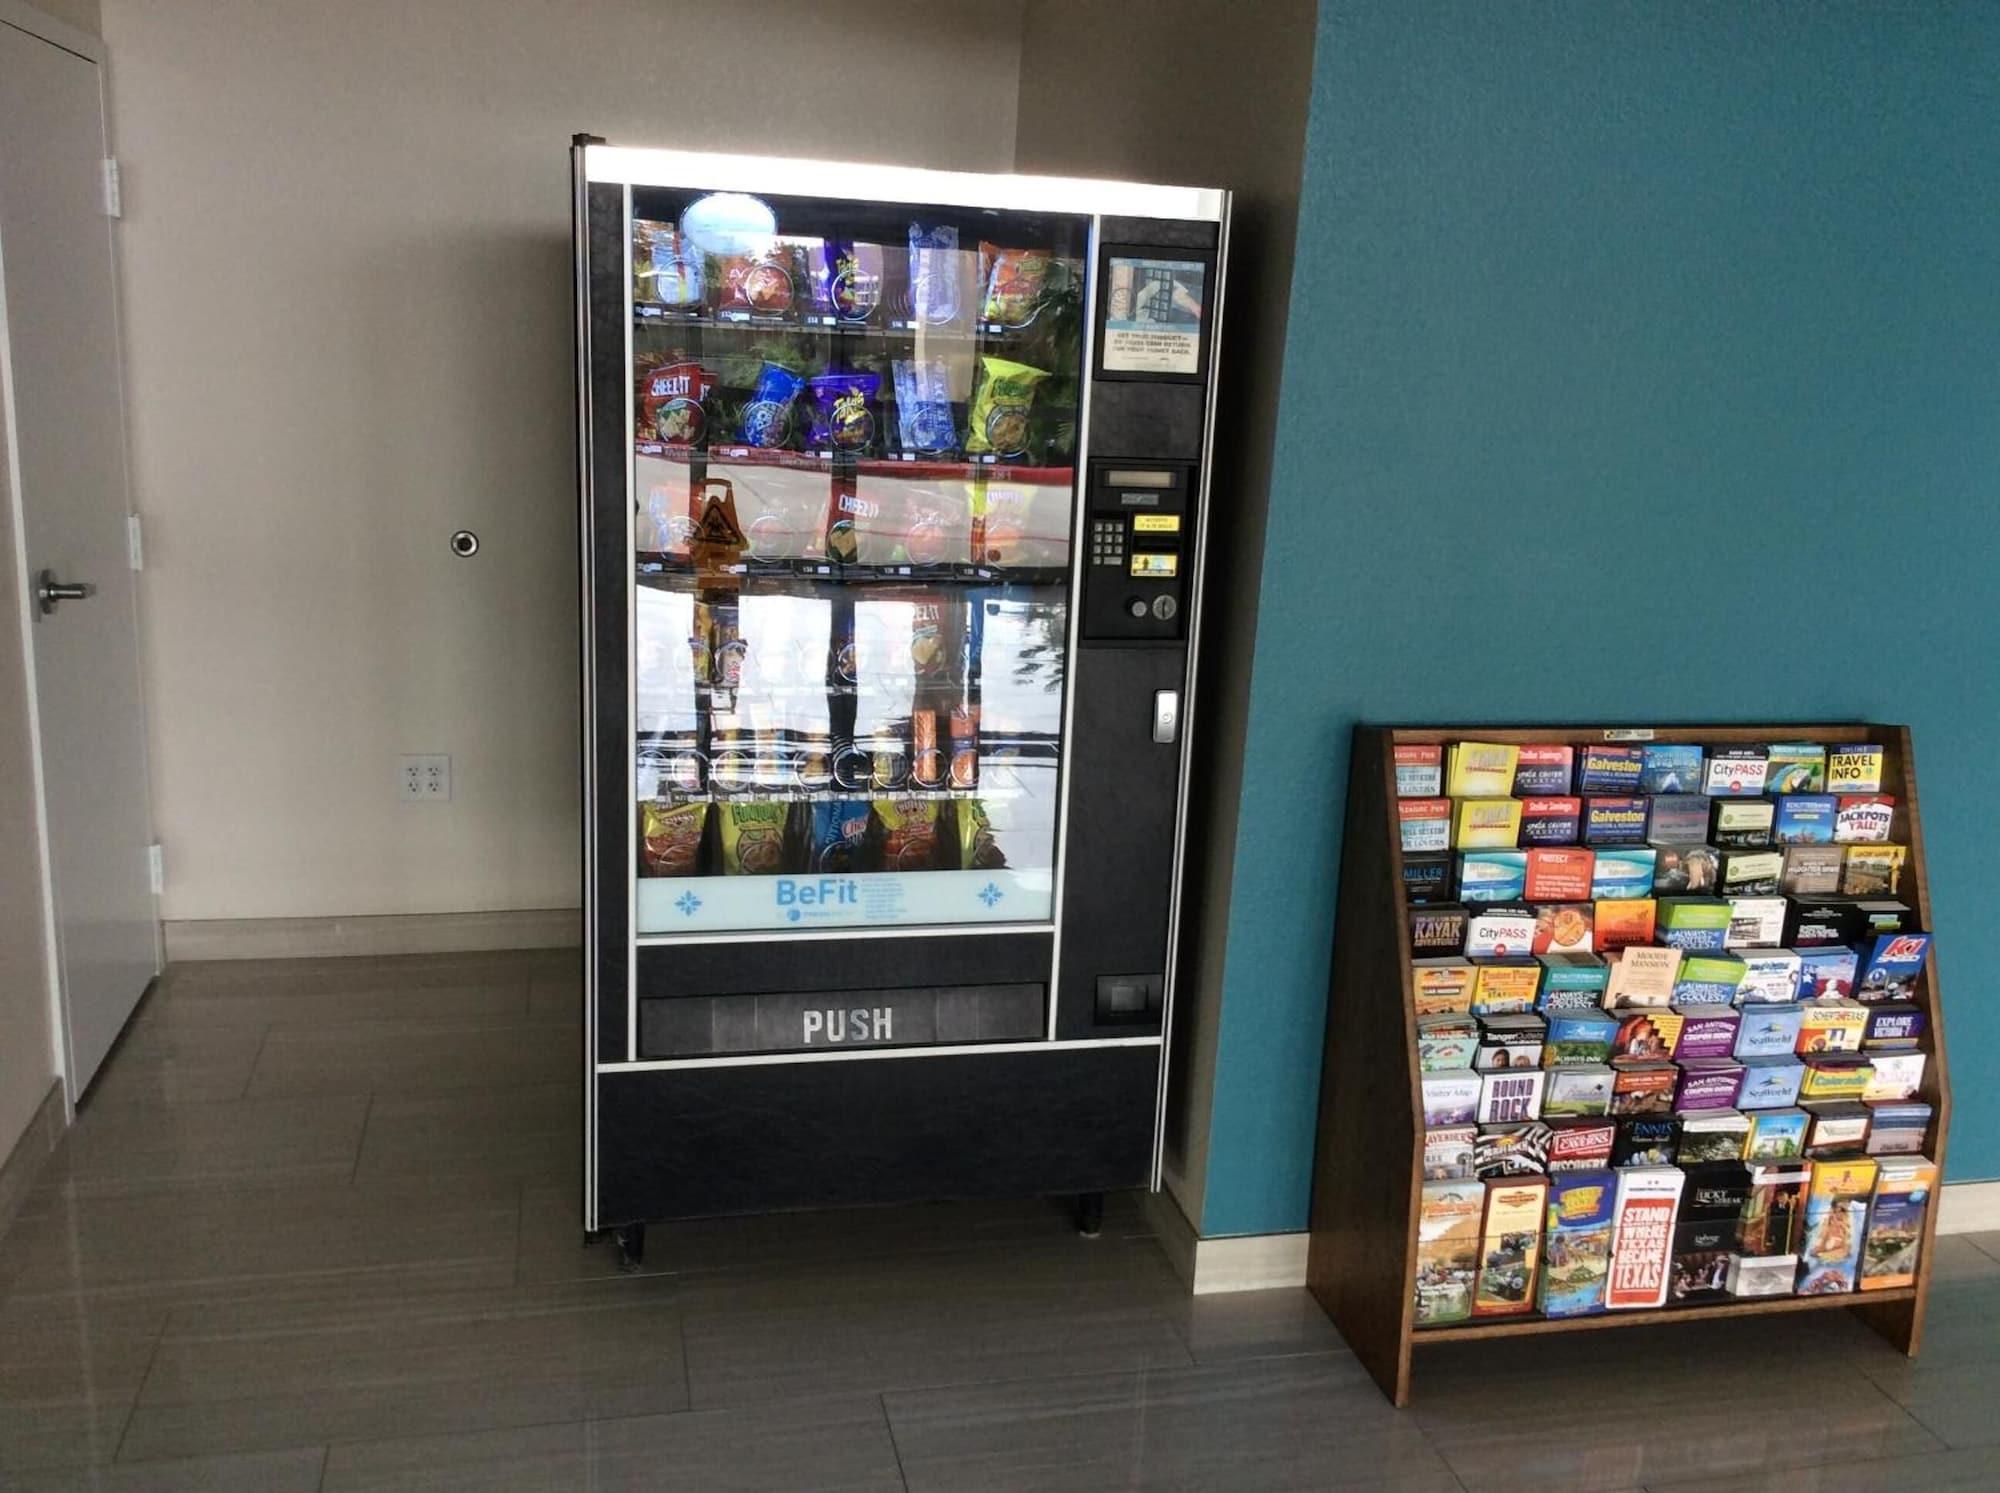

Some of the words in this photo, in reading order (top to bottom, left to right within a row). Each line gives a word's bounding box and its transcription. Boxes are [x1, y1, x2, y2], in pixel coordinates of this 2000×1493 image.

[1588, 757, 1643, 774] Galveston
[1831, 754, 1875, 768] TRAVEL
[1714, 763, 1764, 778] CityPASS
[1831, 767, 1861, 780] INFO
[1591, 810, 1645, 823] Galveston
[1840, 811, 1890, 823] JACKPOTS
[776, 879, 858, 906] BeFit
[1414, 922, 1462, 939] KAYAK
[1479, 927, 1528, 941] CityPASS
[803, 1007, 892, 1043] PUSH
[1876, 1016, 1914, 1027] EXPLORE
[1492, 1078, 1535, 1098] ROUND
[1489, 1098, 1532, 1122] ROCK
[1633, 1121, 1673, 1134] ENNIS
[1624, 1207, 1671, 1222] STAND
[1622, 1224, 1668, 1239] WHERE
[1619, 1240, 1665, 1250] TEXAS
[1618, 1251, 1664, 1264] BECAME
[1615, 1264, 1662, 1290] TEXAS
